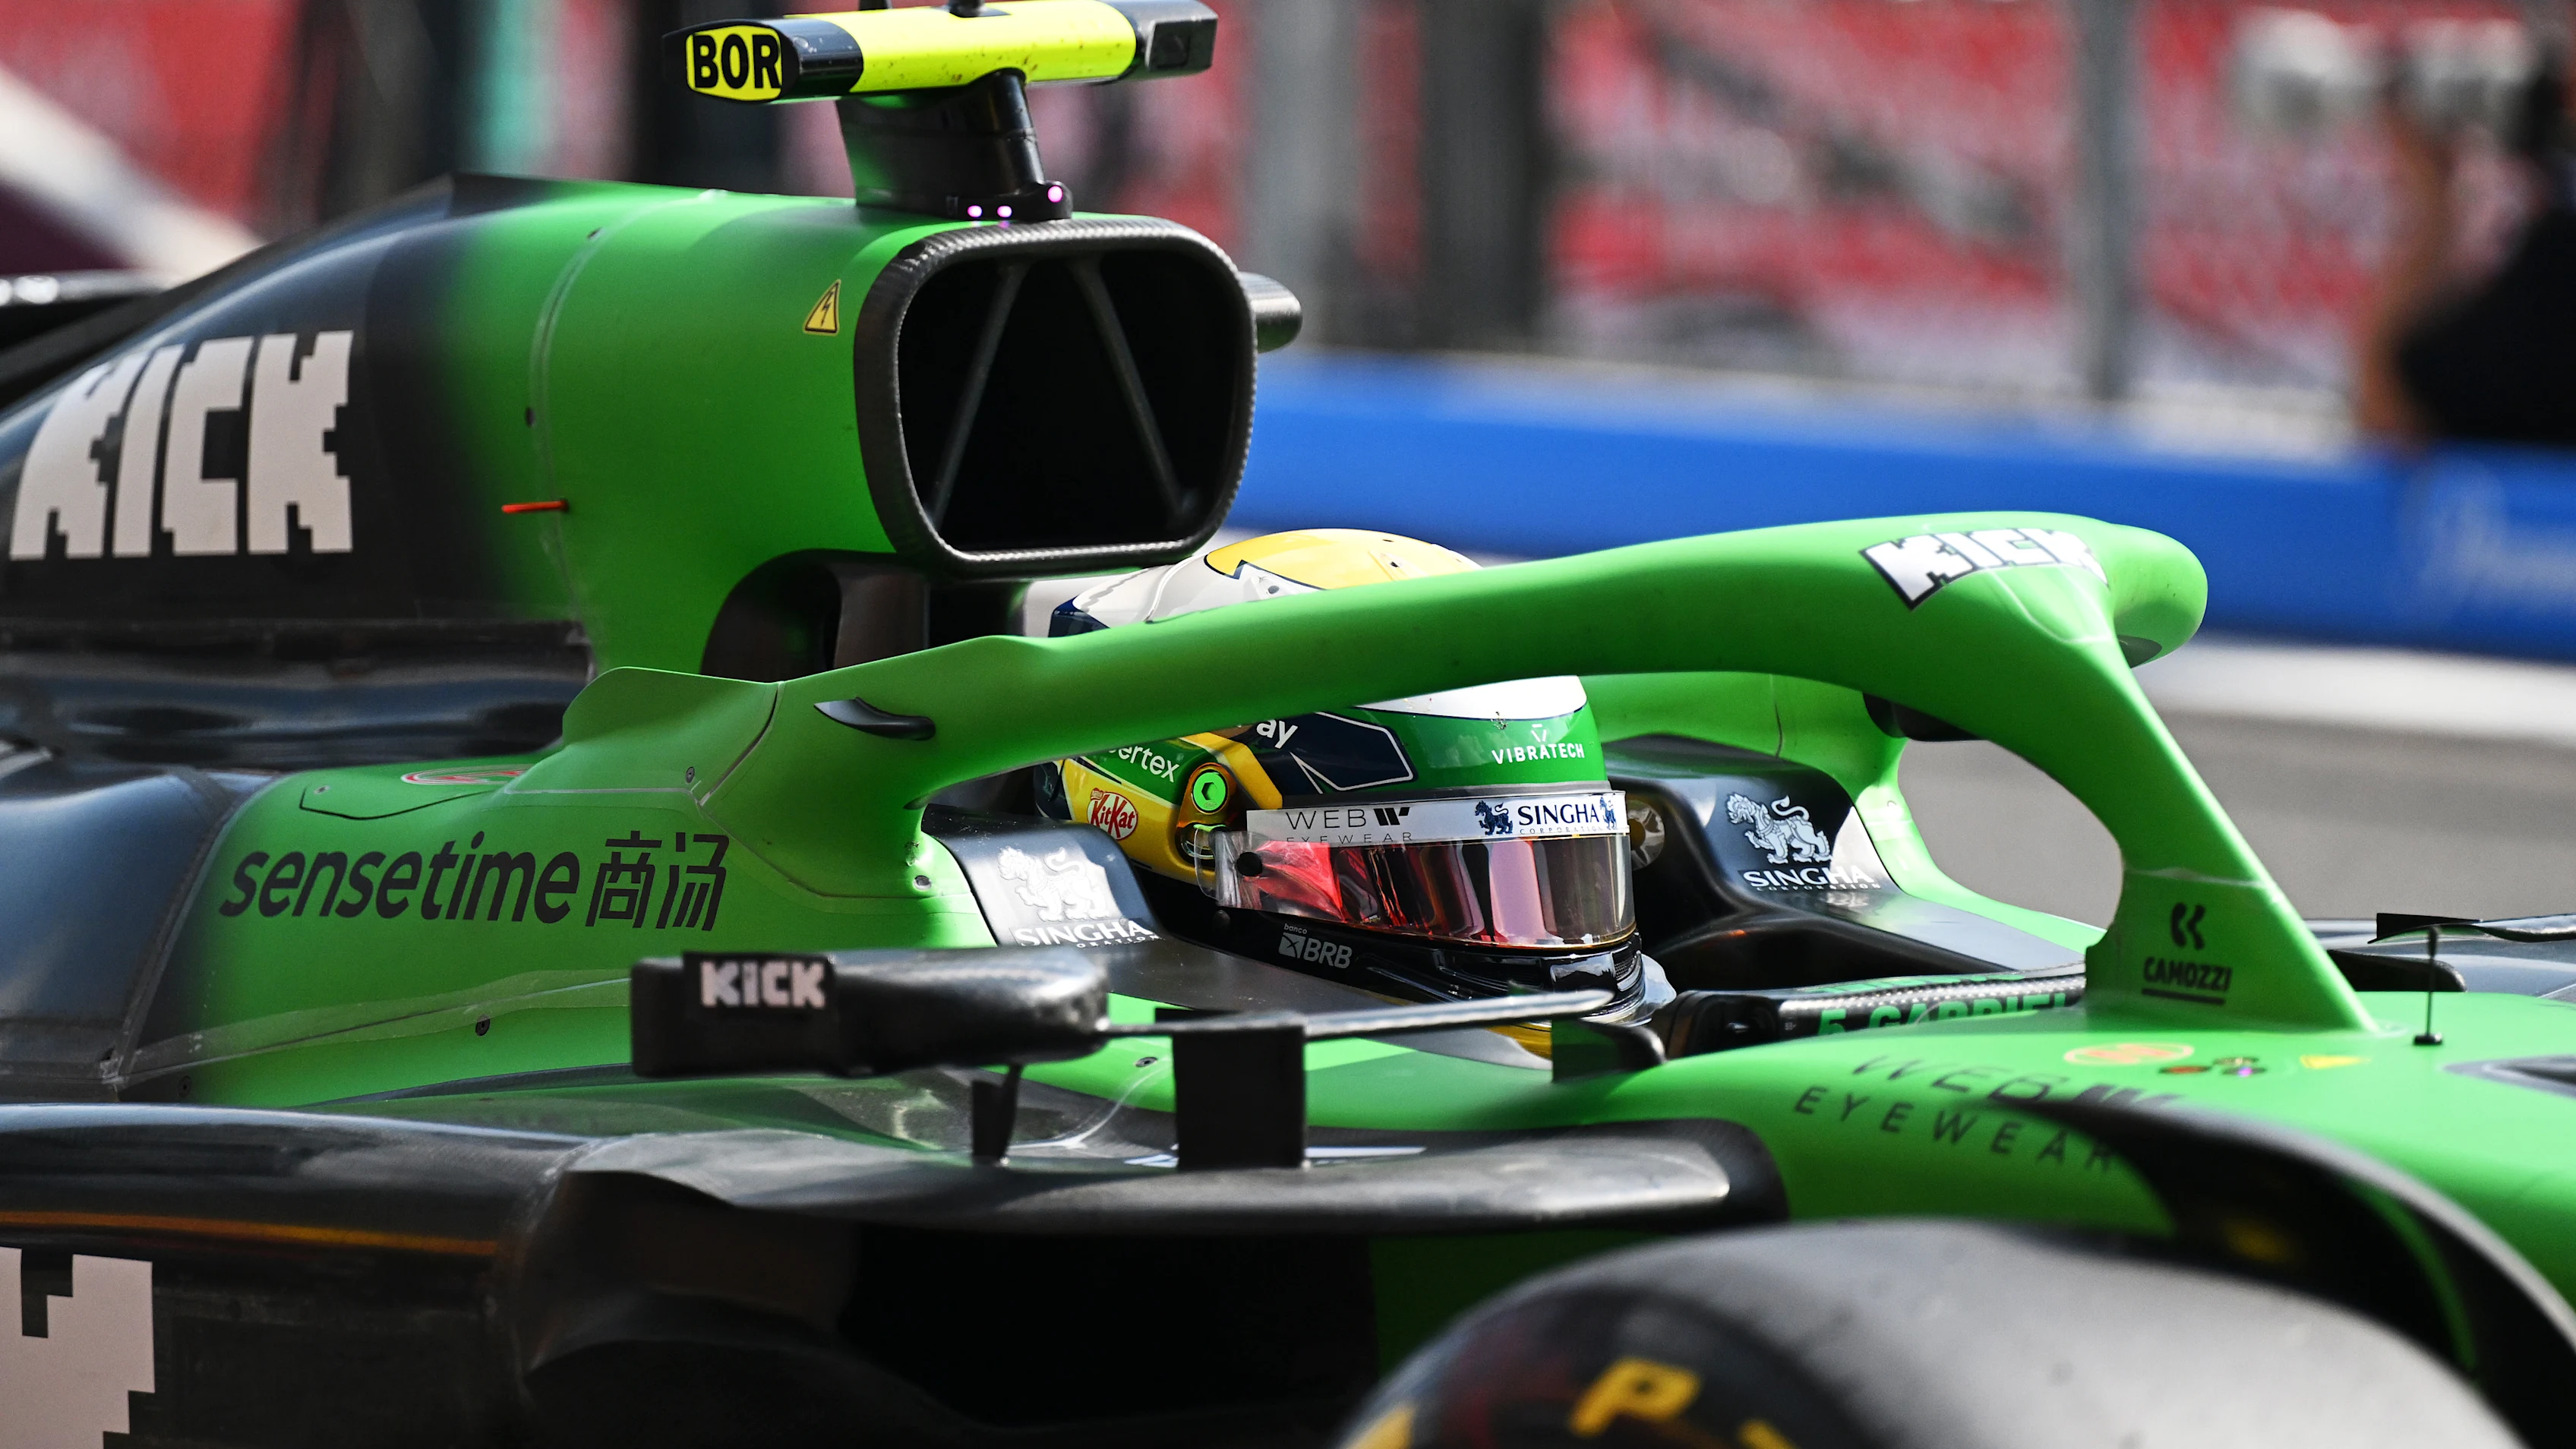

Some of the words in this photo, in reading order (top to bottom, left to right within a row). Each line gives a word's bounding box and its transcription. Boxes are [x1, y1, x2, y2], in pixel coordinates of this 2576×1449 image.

[693, 34, 781, 89] BOR
[10, 330, 353, 560] KICK
[1864, 528, 2109, 603] KICK
[1108, 745, 1179, 783] ertex
[1492, 743, 1585, 765] VIBRATECH
[1091, 794, 1135, 838] KitKat
[1286, 809, 1366, 830] WEB
[1517, 803, 1599, 826] SINGHA
[219, 831, 580, 923] sensetime
[585, 831, 729, 931] 商汤
[1743, 866, 1875, 887] SINGHA
[1015, 920, 1153, 947] SINGHA
[1283, 923, 1308, 935] banco
[1303, 938, 1353, 969] BRB
[701, 961, 826, 1008] KICK
[2143, 956, 2233, 992] CAMOZZI
[1794, 1086, 2120, 1174] EYEWEAR
